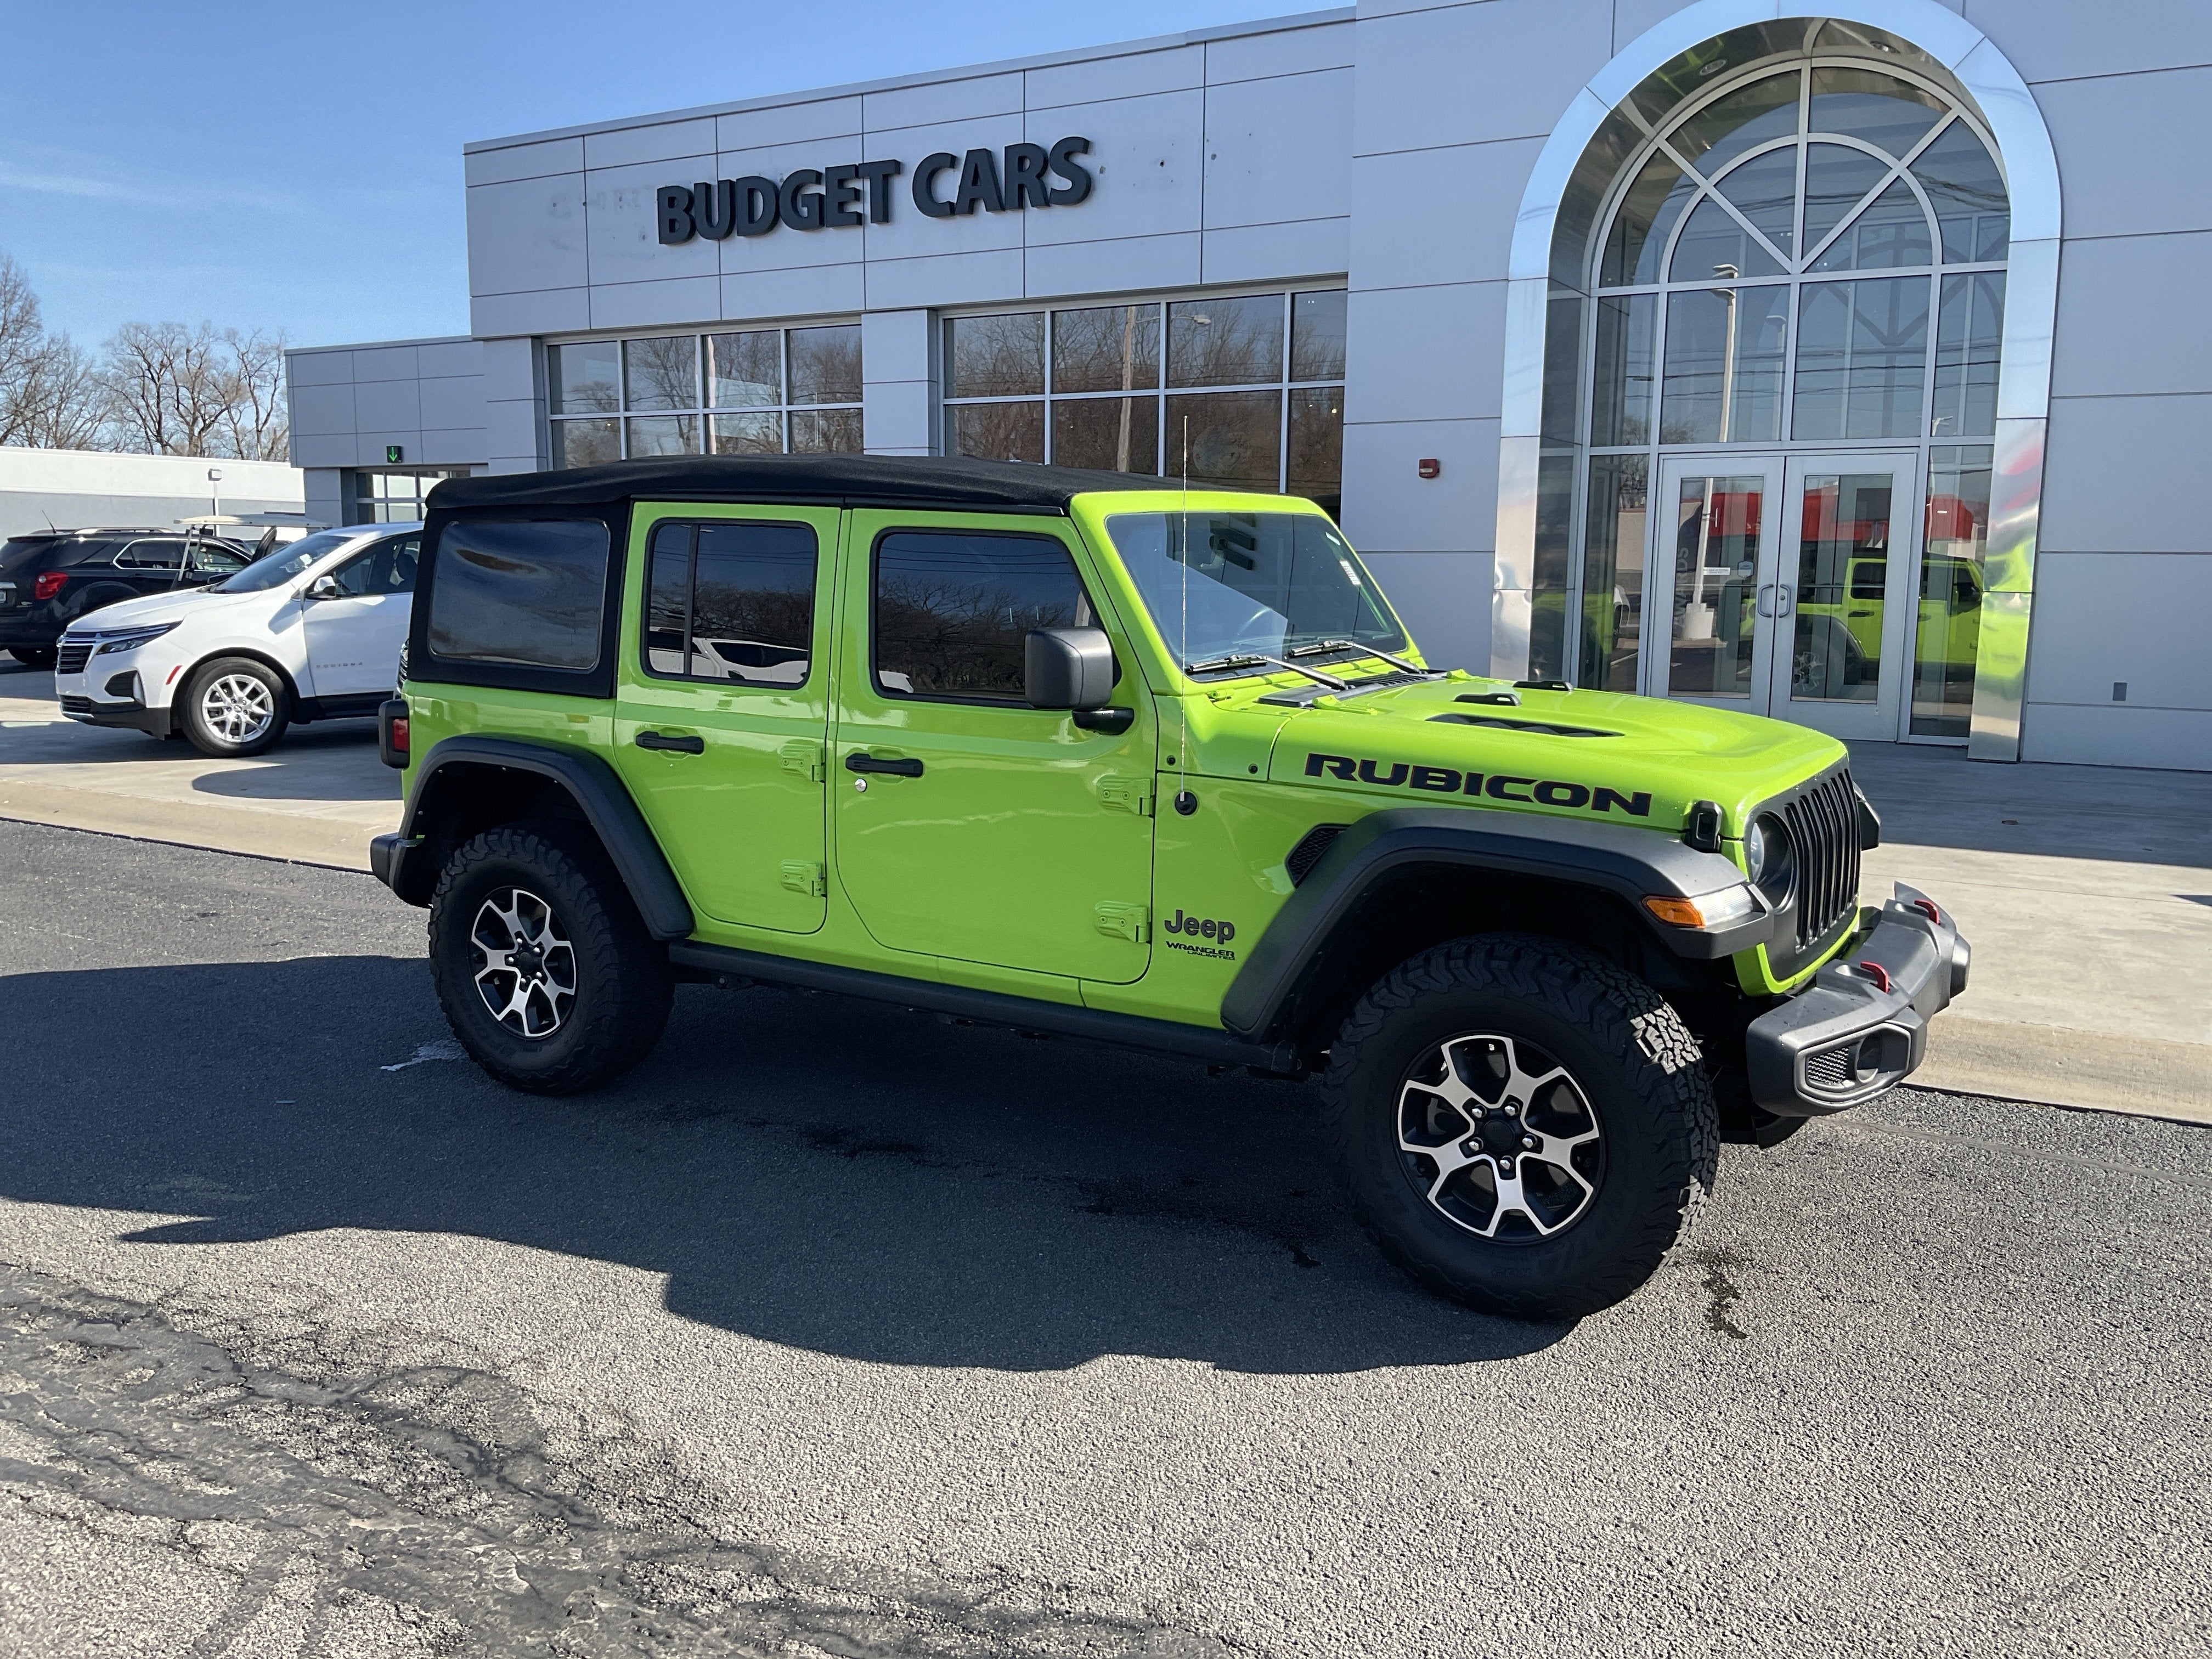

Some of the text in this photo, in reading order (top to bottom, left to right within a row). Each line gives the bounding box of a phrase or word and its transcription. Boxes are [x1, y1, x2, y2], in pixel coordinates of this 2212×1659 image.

[657, 136, 1092, 245] BUDGET CARS
[1304, 753, 1652, 817] RUBICON
[1164, 909, 1235, 945] Jeep
[1165, 940, 1235, 957] WRANGLER
[1187, 950, 1235, 961] UNLIMITED
